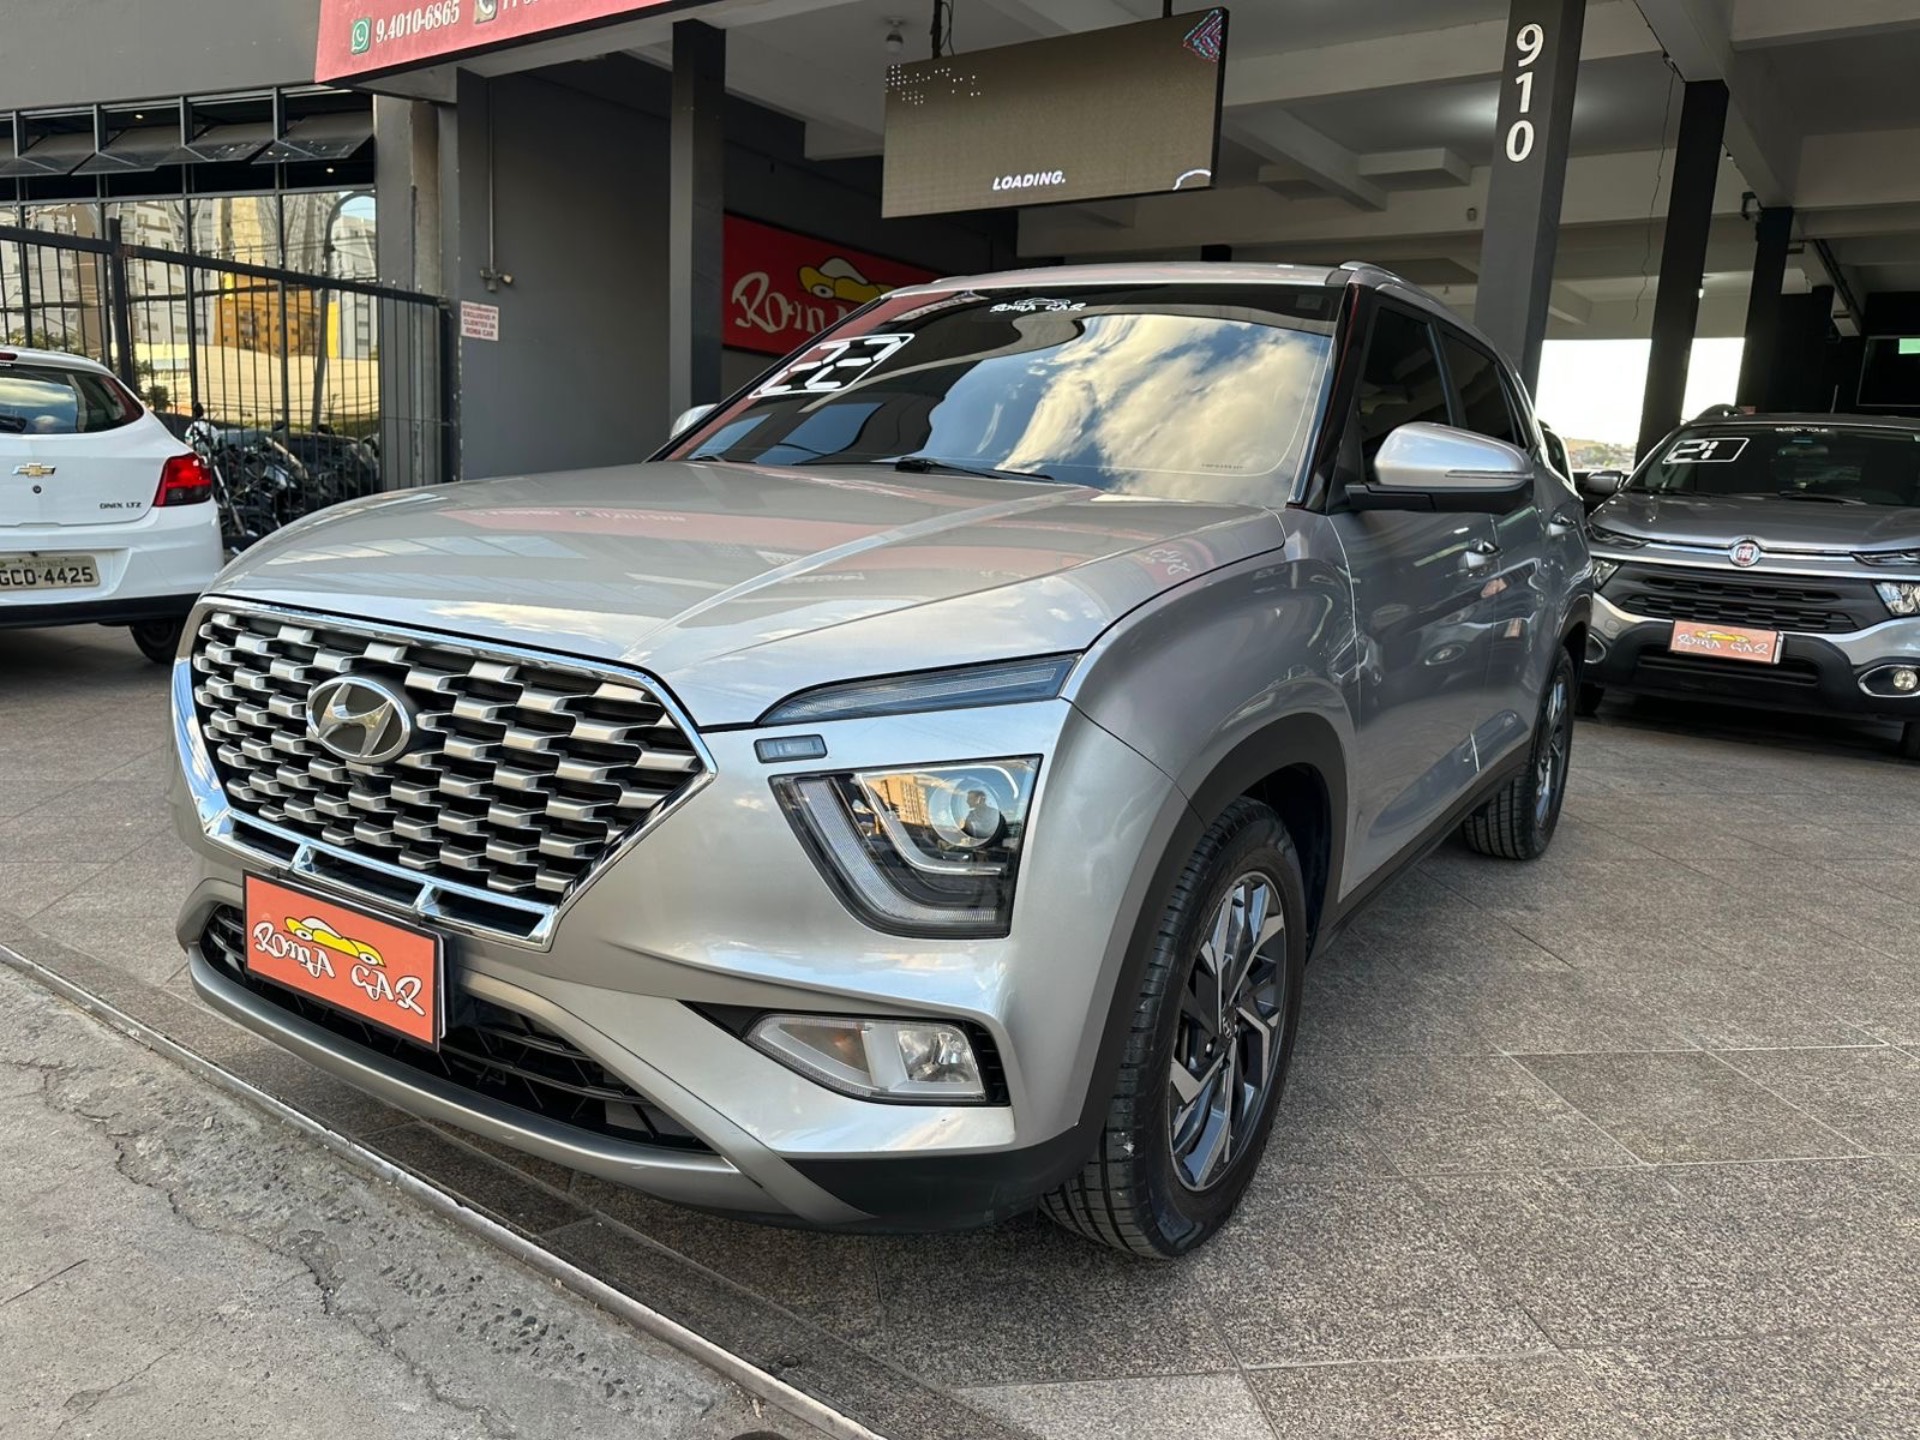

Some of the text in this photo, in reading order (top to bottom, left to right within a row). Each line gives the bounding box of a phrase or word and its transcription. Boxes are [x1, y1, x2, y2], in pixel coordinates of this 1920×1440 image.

[376, 1, 460, 43] 9.4010-6865
[1505, 23, 1544, 162] 910
[993, 170, 1066, 191] LOADING.
[99, 501, 142, 510] ONIX LTZ
